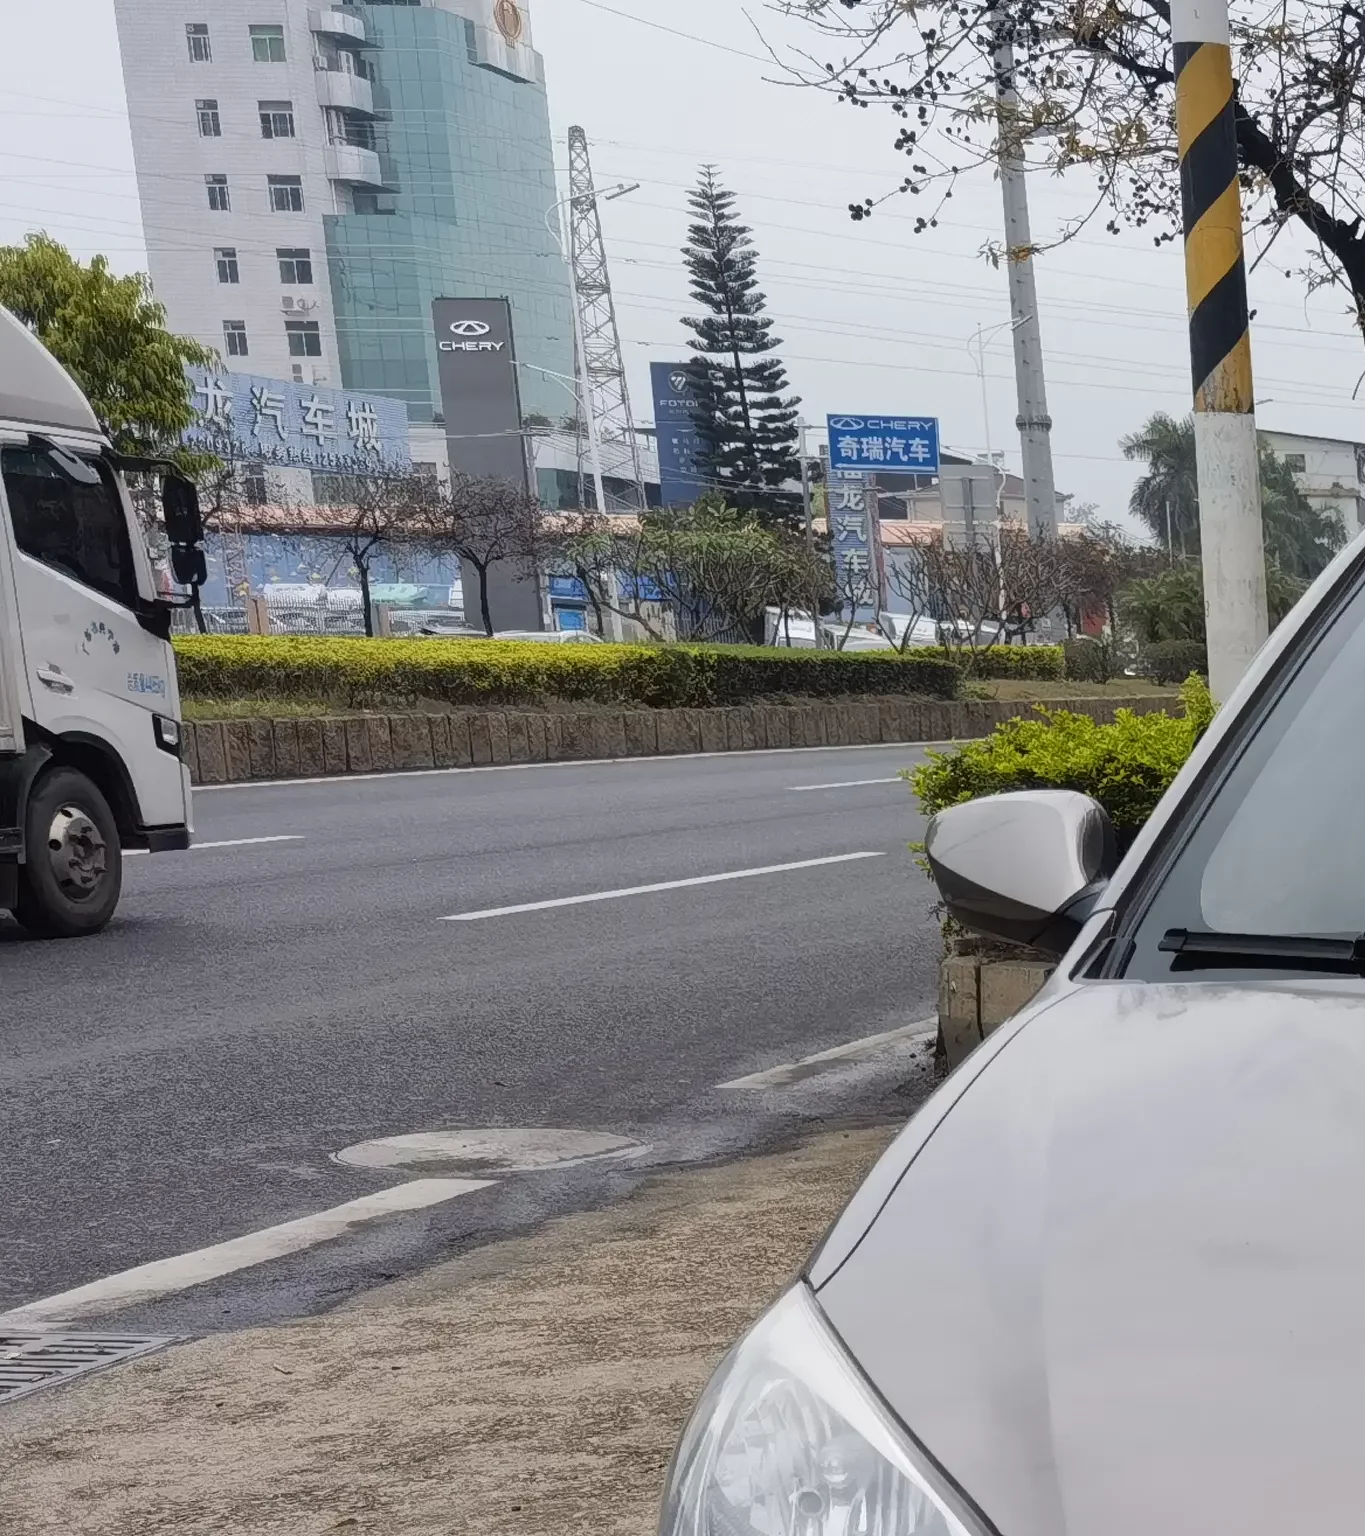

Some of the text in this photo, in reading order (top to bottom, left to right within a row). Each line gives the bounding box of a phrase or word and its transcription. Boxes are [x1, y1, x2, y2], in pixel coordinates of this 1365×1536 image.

[439, 341, 504, 352] CHERY
[867, 419, 933, 431] CHERY
[837, 435, 931, 463] 奇瑞汽车
